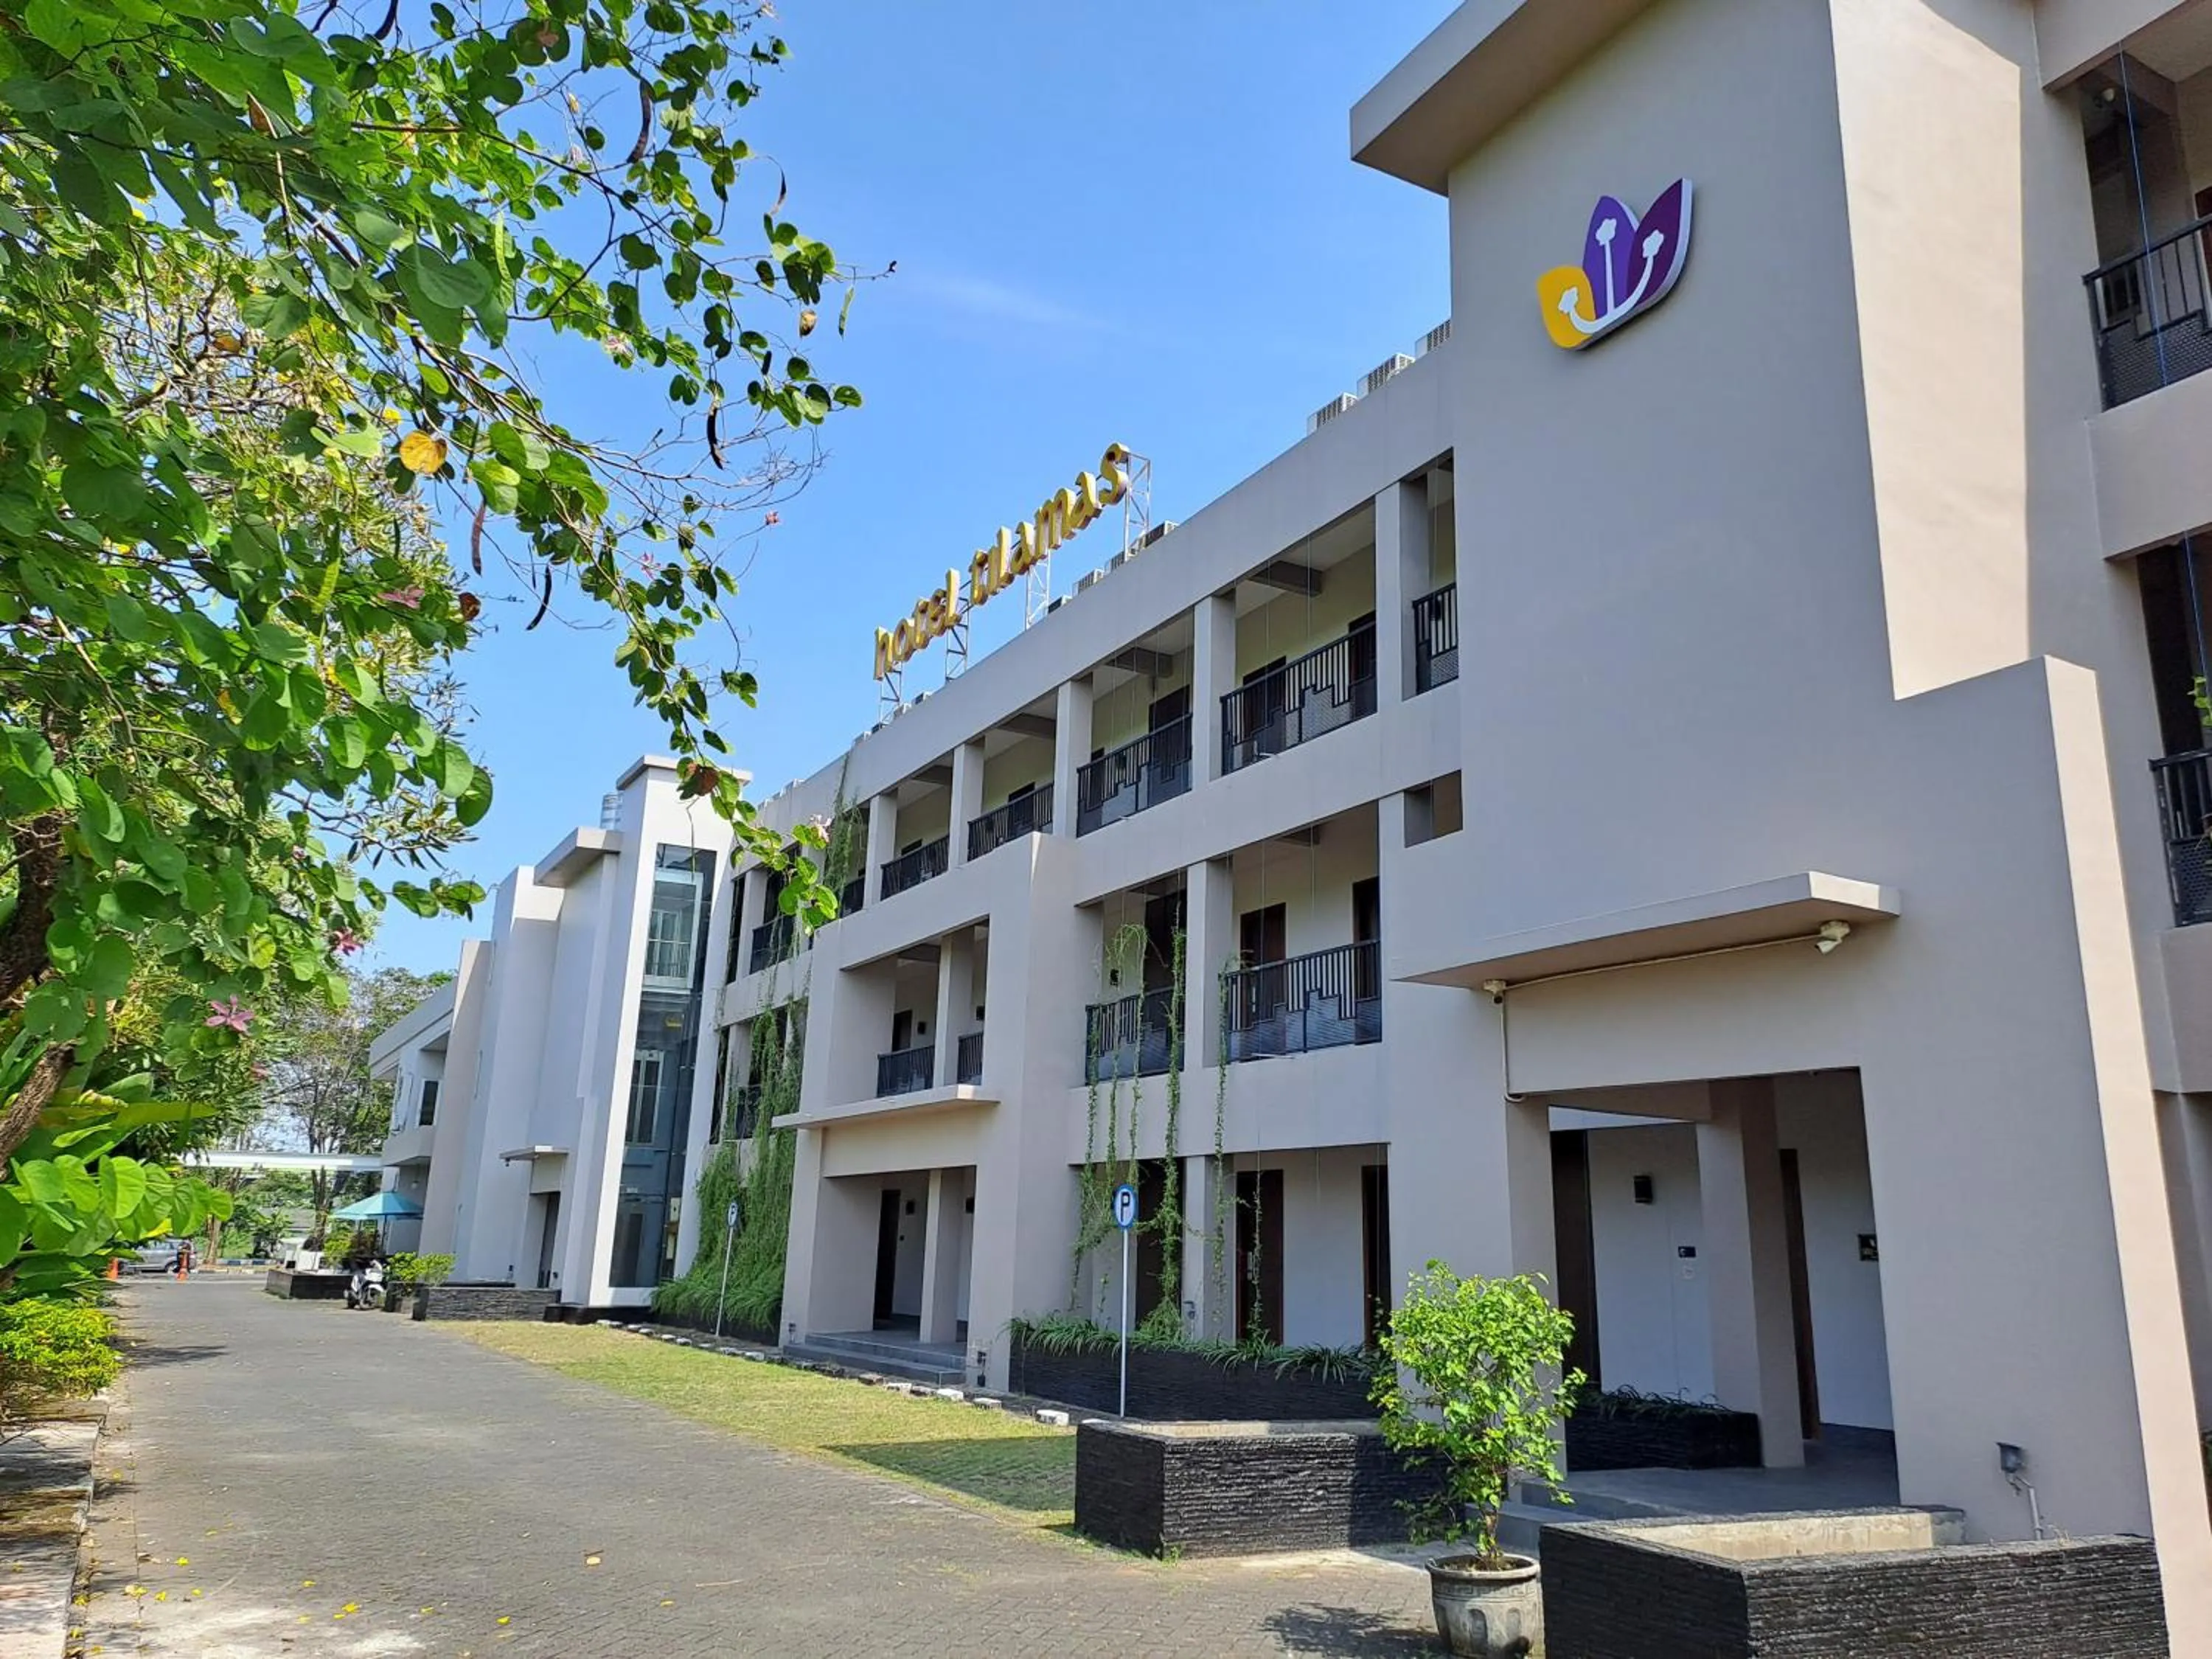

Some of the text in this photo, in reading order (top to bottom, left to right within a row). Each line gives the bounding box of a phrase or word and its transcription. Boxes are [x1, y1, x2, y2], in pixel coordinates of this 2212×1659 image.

[874, 442, 1130, 681] hotel tilamas
[1121, 1192, 1130, 1222] P
